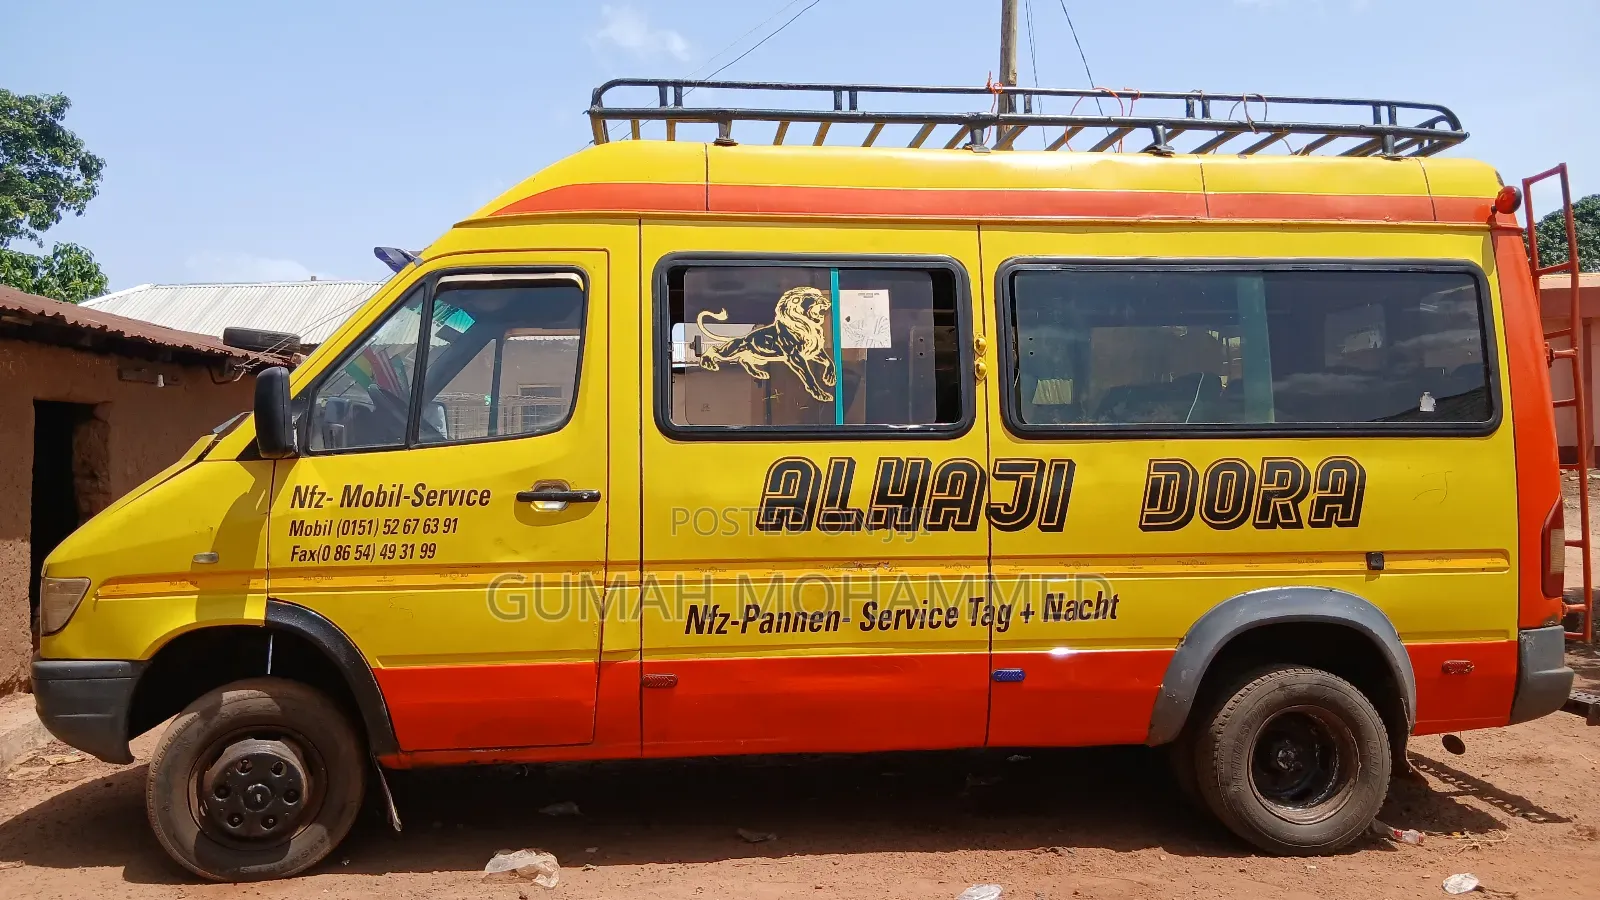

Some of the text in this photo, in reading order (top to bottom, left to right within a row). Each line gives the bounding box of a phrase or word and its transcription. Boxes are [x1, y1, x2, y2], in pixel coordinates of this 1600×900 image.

[290, 482, 492, 509] Nfz- Mobil-Service
[755, 454, 1367, 532] ALHAJI DORA
[288, 517, 459, 538] Mobil (0151) 52 67 63 91
[333, 544, 352, 562] 86
[354, 542, 376, 563] 54)
[379, 543, 397, 560] 49
[399, 543, 416, 560] 31
[419, 542, 437, 559] 99
[684, 590, 1120, 635] Nfz-Pannen- Service Tag + Nacht
